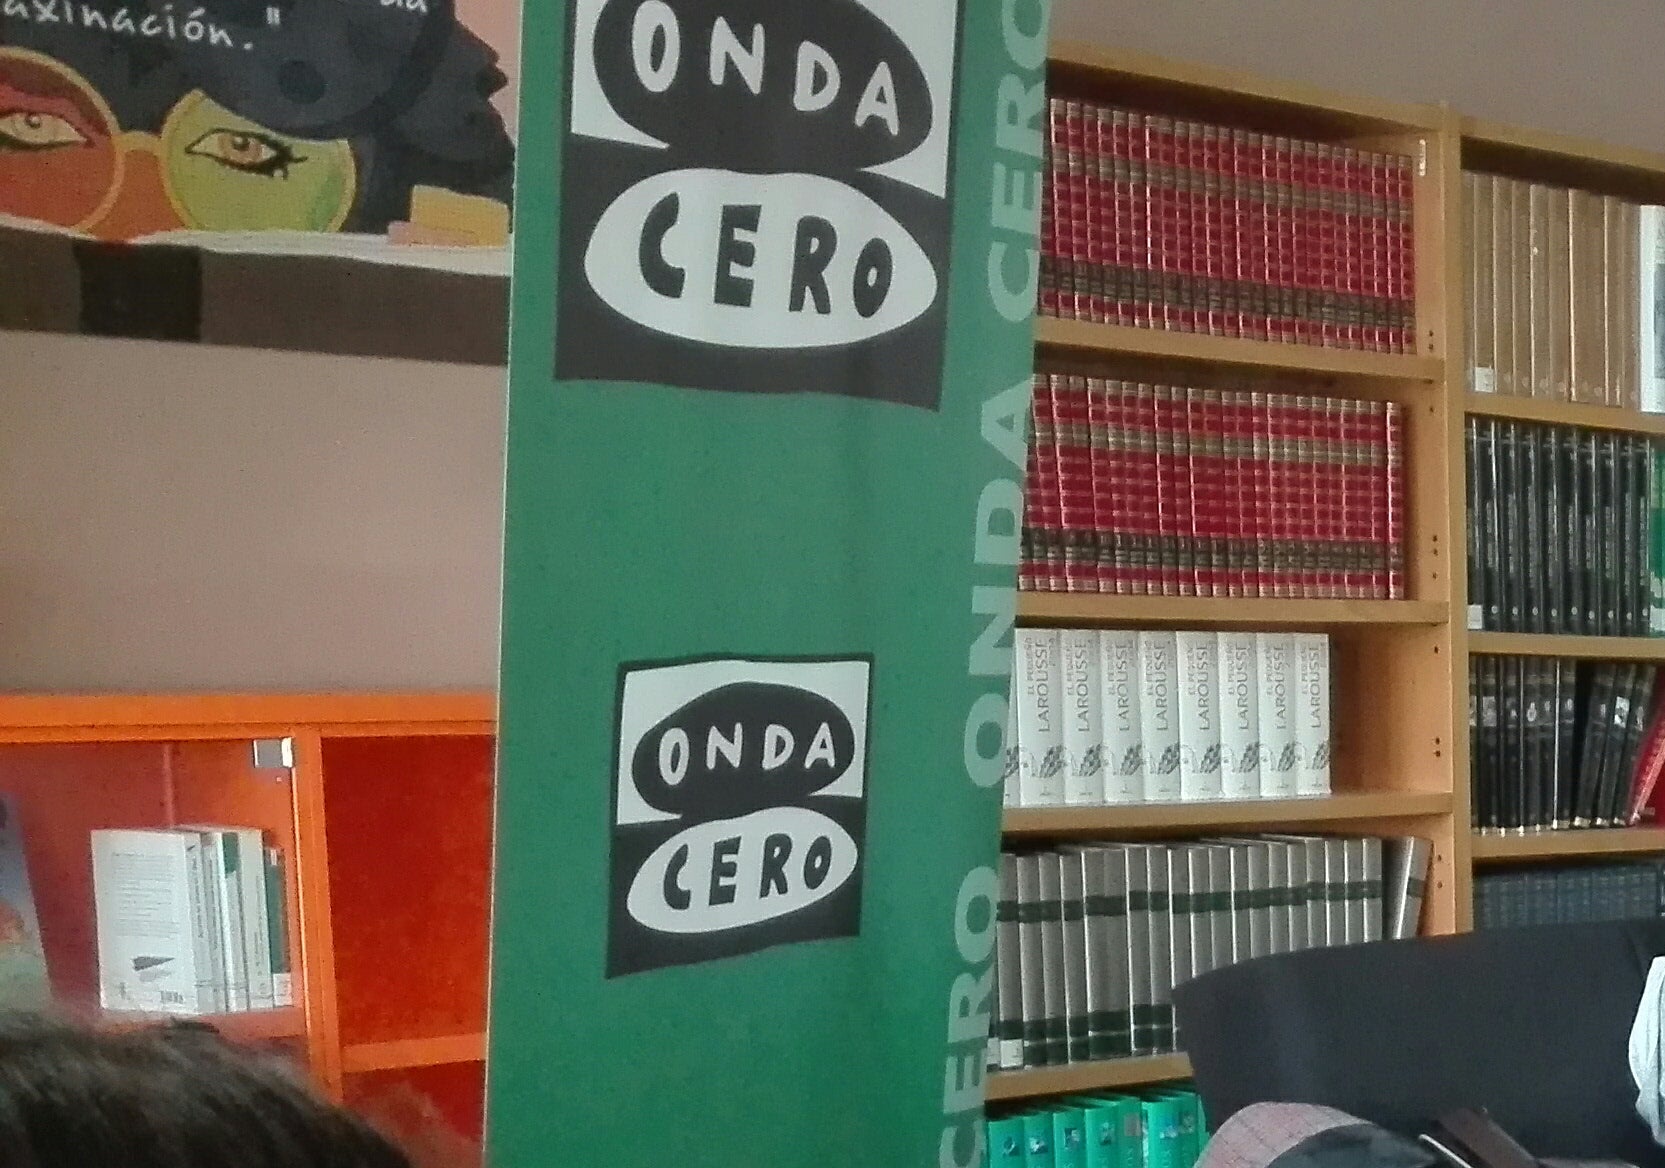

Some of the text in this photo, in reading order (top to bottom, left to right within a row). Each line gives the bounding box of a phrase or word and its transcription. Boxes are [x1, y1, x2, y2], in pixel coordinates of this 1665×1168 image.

[632, 0, 900, 136] ONDA
[987, 0, 1051, 323] CERO
[638, 192, 893, 319] CERO
[964, 375, 1035, 788] ONDA
[1035, 640, 1050, 732] LAROUSSE
[1074, 640, 1090, 732] LAROUSSE
[1115, 641, 1130, 731] LAROUSSE
[1154, 641, 1168, 731] LAROUSSE
[1196, 642, 1210, 730] LAROUSSE
[1236, 642, 1249, 730] LAROUSSE
[1274, 643, 1287, 729] LAROUSSE
[1309, 643, 1322, 728] LAROUSSE
[658, 721, 837, 786] ONDA
[663, 832, 834, 912] CERO
